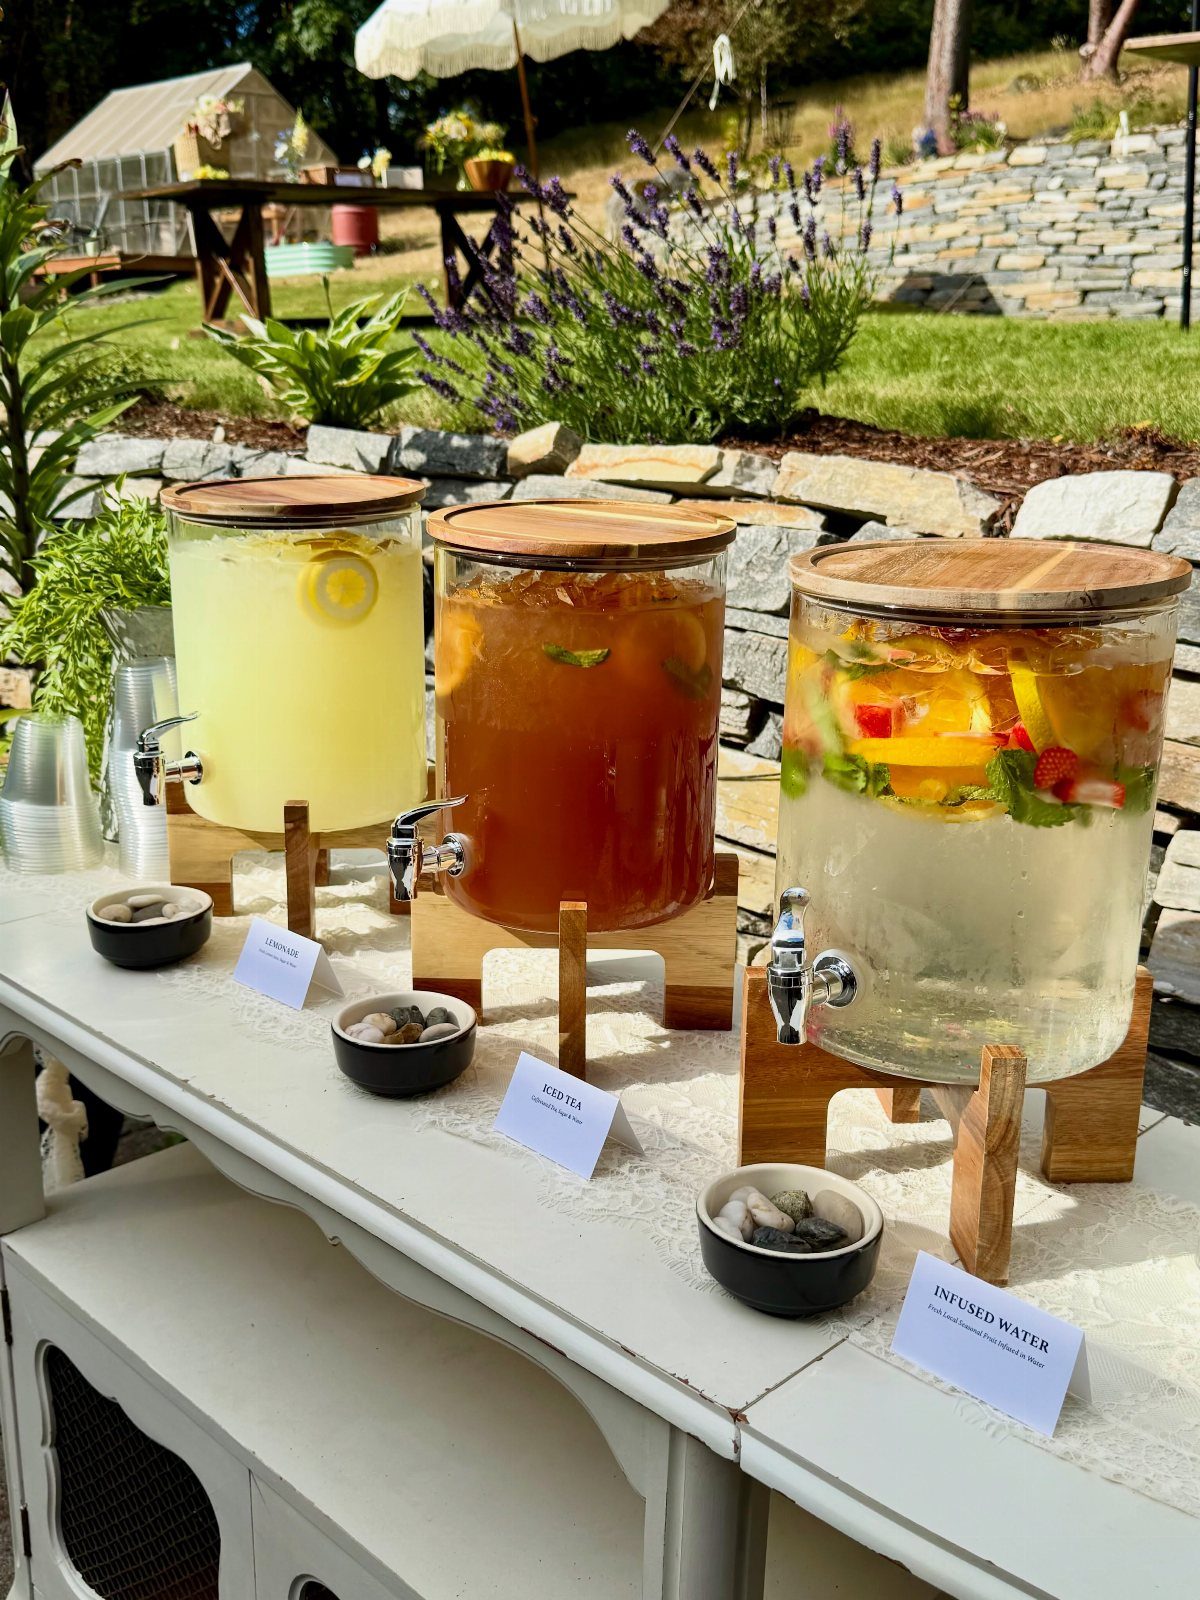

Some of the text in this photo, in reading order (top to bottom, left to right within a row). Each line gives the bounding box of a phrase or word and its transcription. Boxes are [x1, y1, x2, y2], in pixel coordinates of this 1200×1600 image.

[265, 937, 299, 958] LEMONADE
[542, 1083, 582, 1111] ICED TEA
[927, 1303, 1046, 1369] Fresh Local Seasonal Fruit Infused in Water
[934, 1284, 1049, 1354] INFUSED WATER
